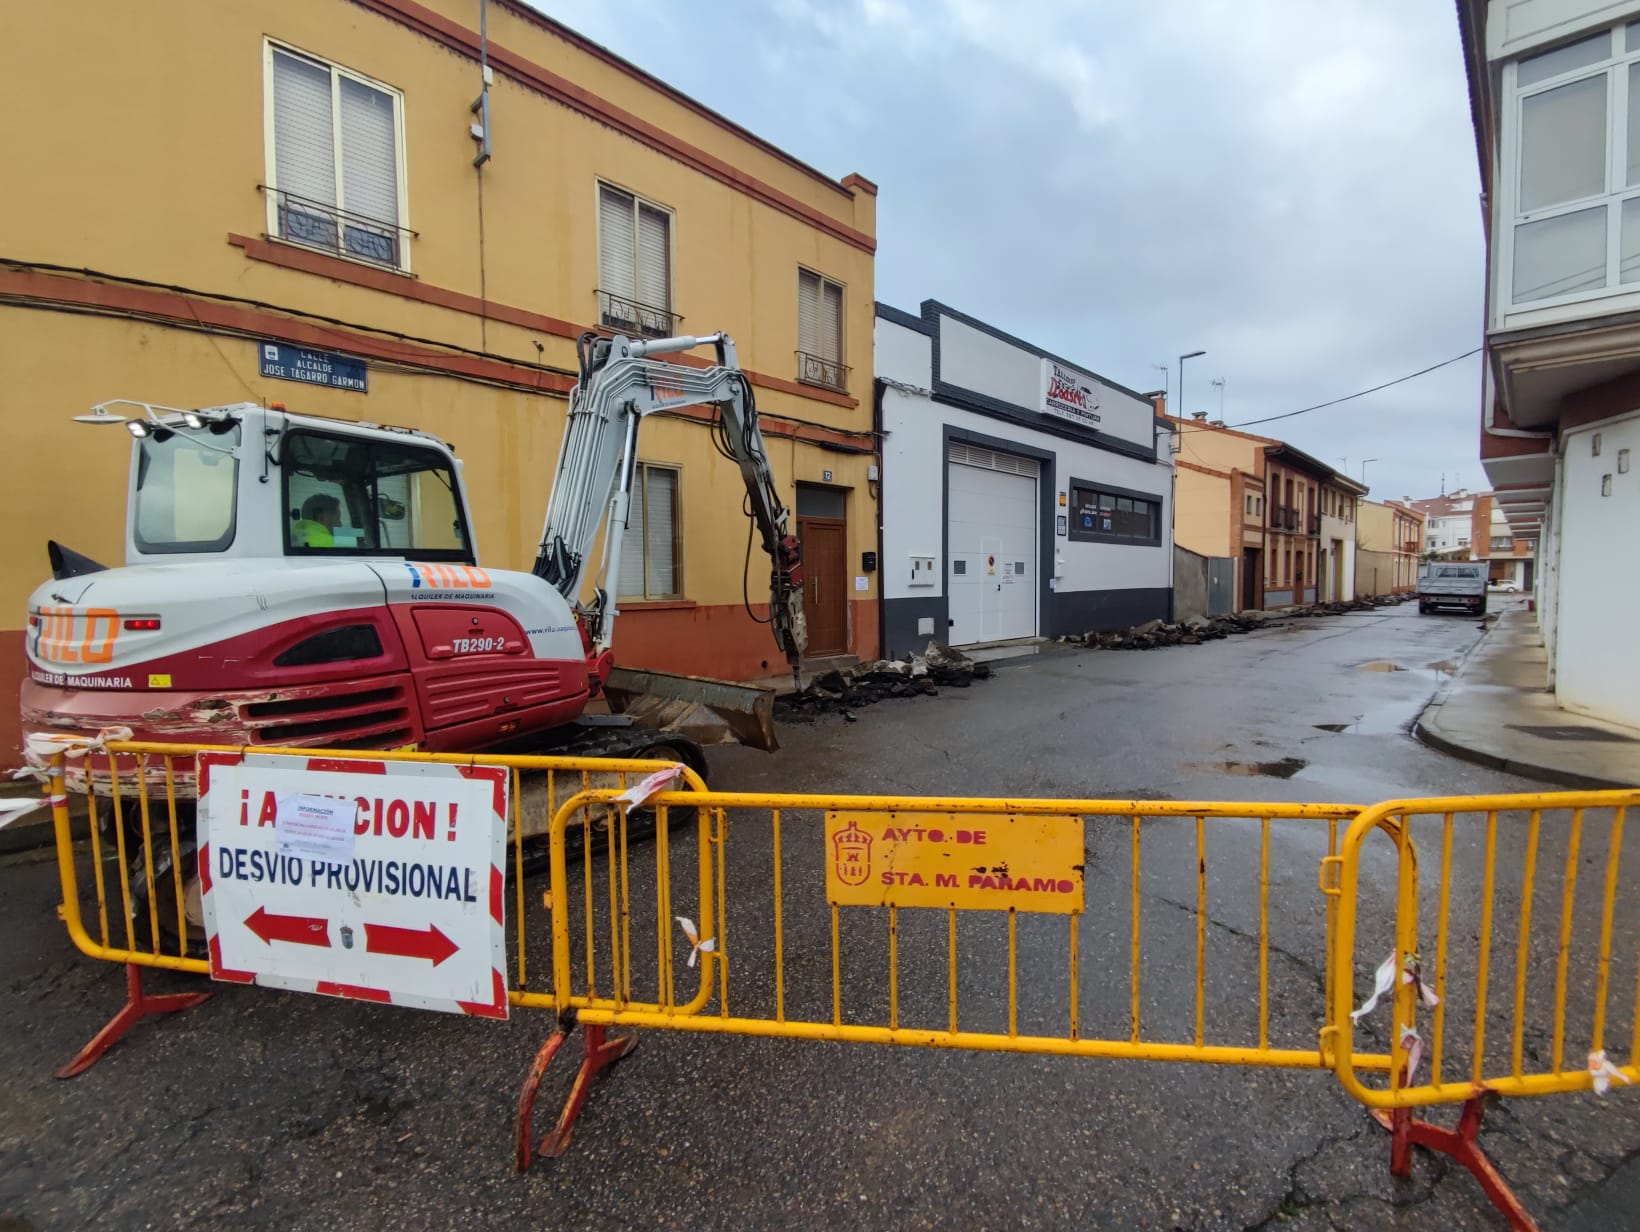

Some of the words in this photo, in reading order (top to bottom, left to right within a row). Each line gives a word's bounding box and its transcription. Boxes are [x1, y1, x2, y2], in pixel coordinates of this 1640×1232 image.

[296, 359, 333, 373] ALCALDE
[263, 364, 286, 376] JOSE
[291, 367, 328, 384] TAGARRO
[332, 375, 365, 389] GARMON
[824, 471, 831, 480] 12
[453, 636, 505, 653] TB290-2
[67, 676, 132, 688] MAQUINARIA
[240, 789, 458, 842] ¡ACION!
[956, 830, 987, 845] DE
[219, 847, 303, 886] DESVIO
[311, 858, 477, 902] PROVISIONAL
[881, 871, 929, 887] STA.
